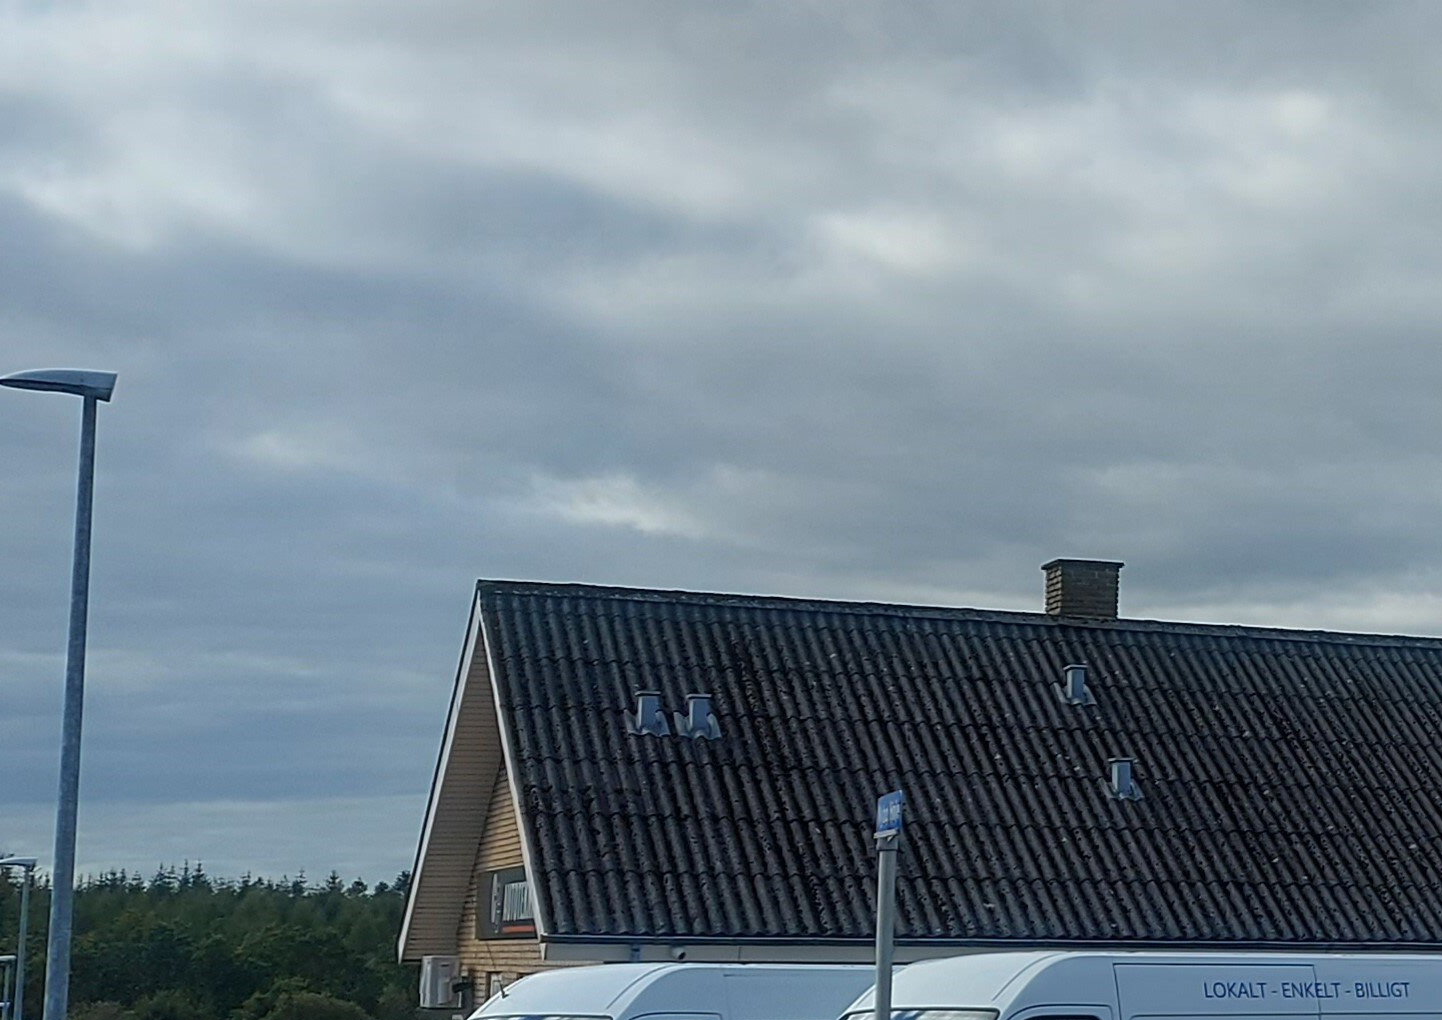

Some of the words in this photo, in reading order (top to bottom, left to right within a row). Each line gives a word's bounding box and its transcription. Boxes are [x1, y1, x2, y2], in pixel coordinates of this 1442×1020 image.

[1204, 982, 1267, 999] LOKALT
[1281, 982, 1341, 998] ENKELT
[1355, 982, 1410, 998] BILLIGT
